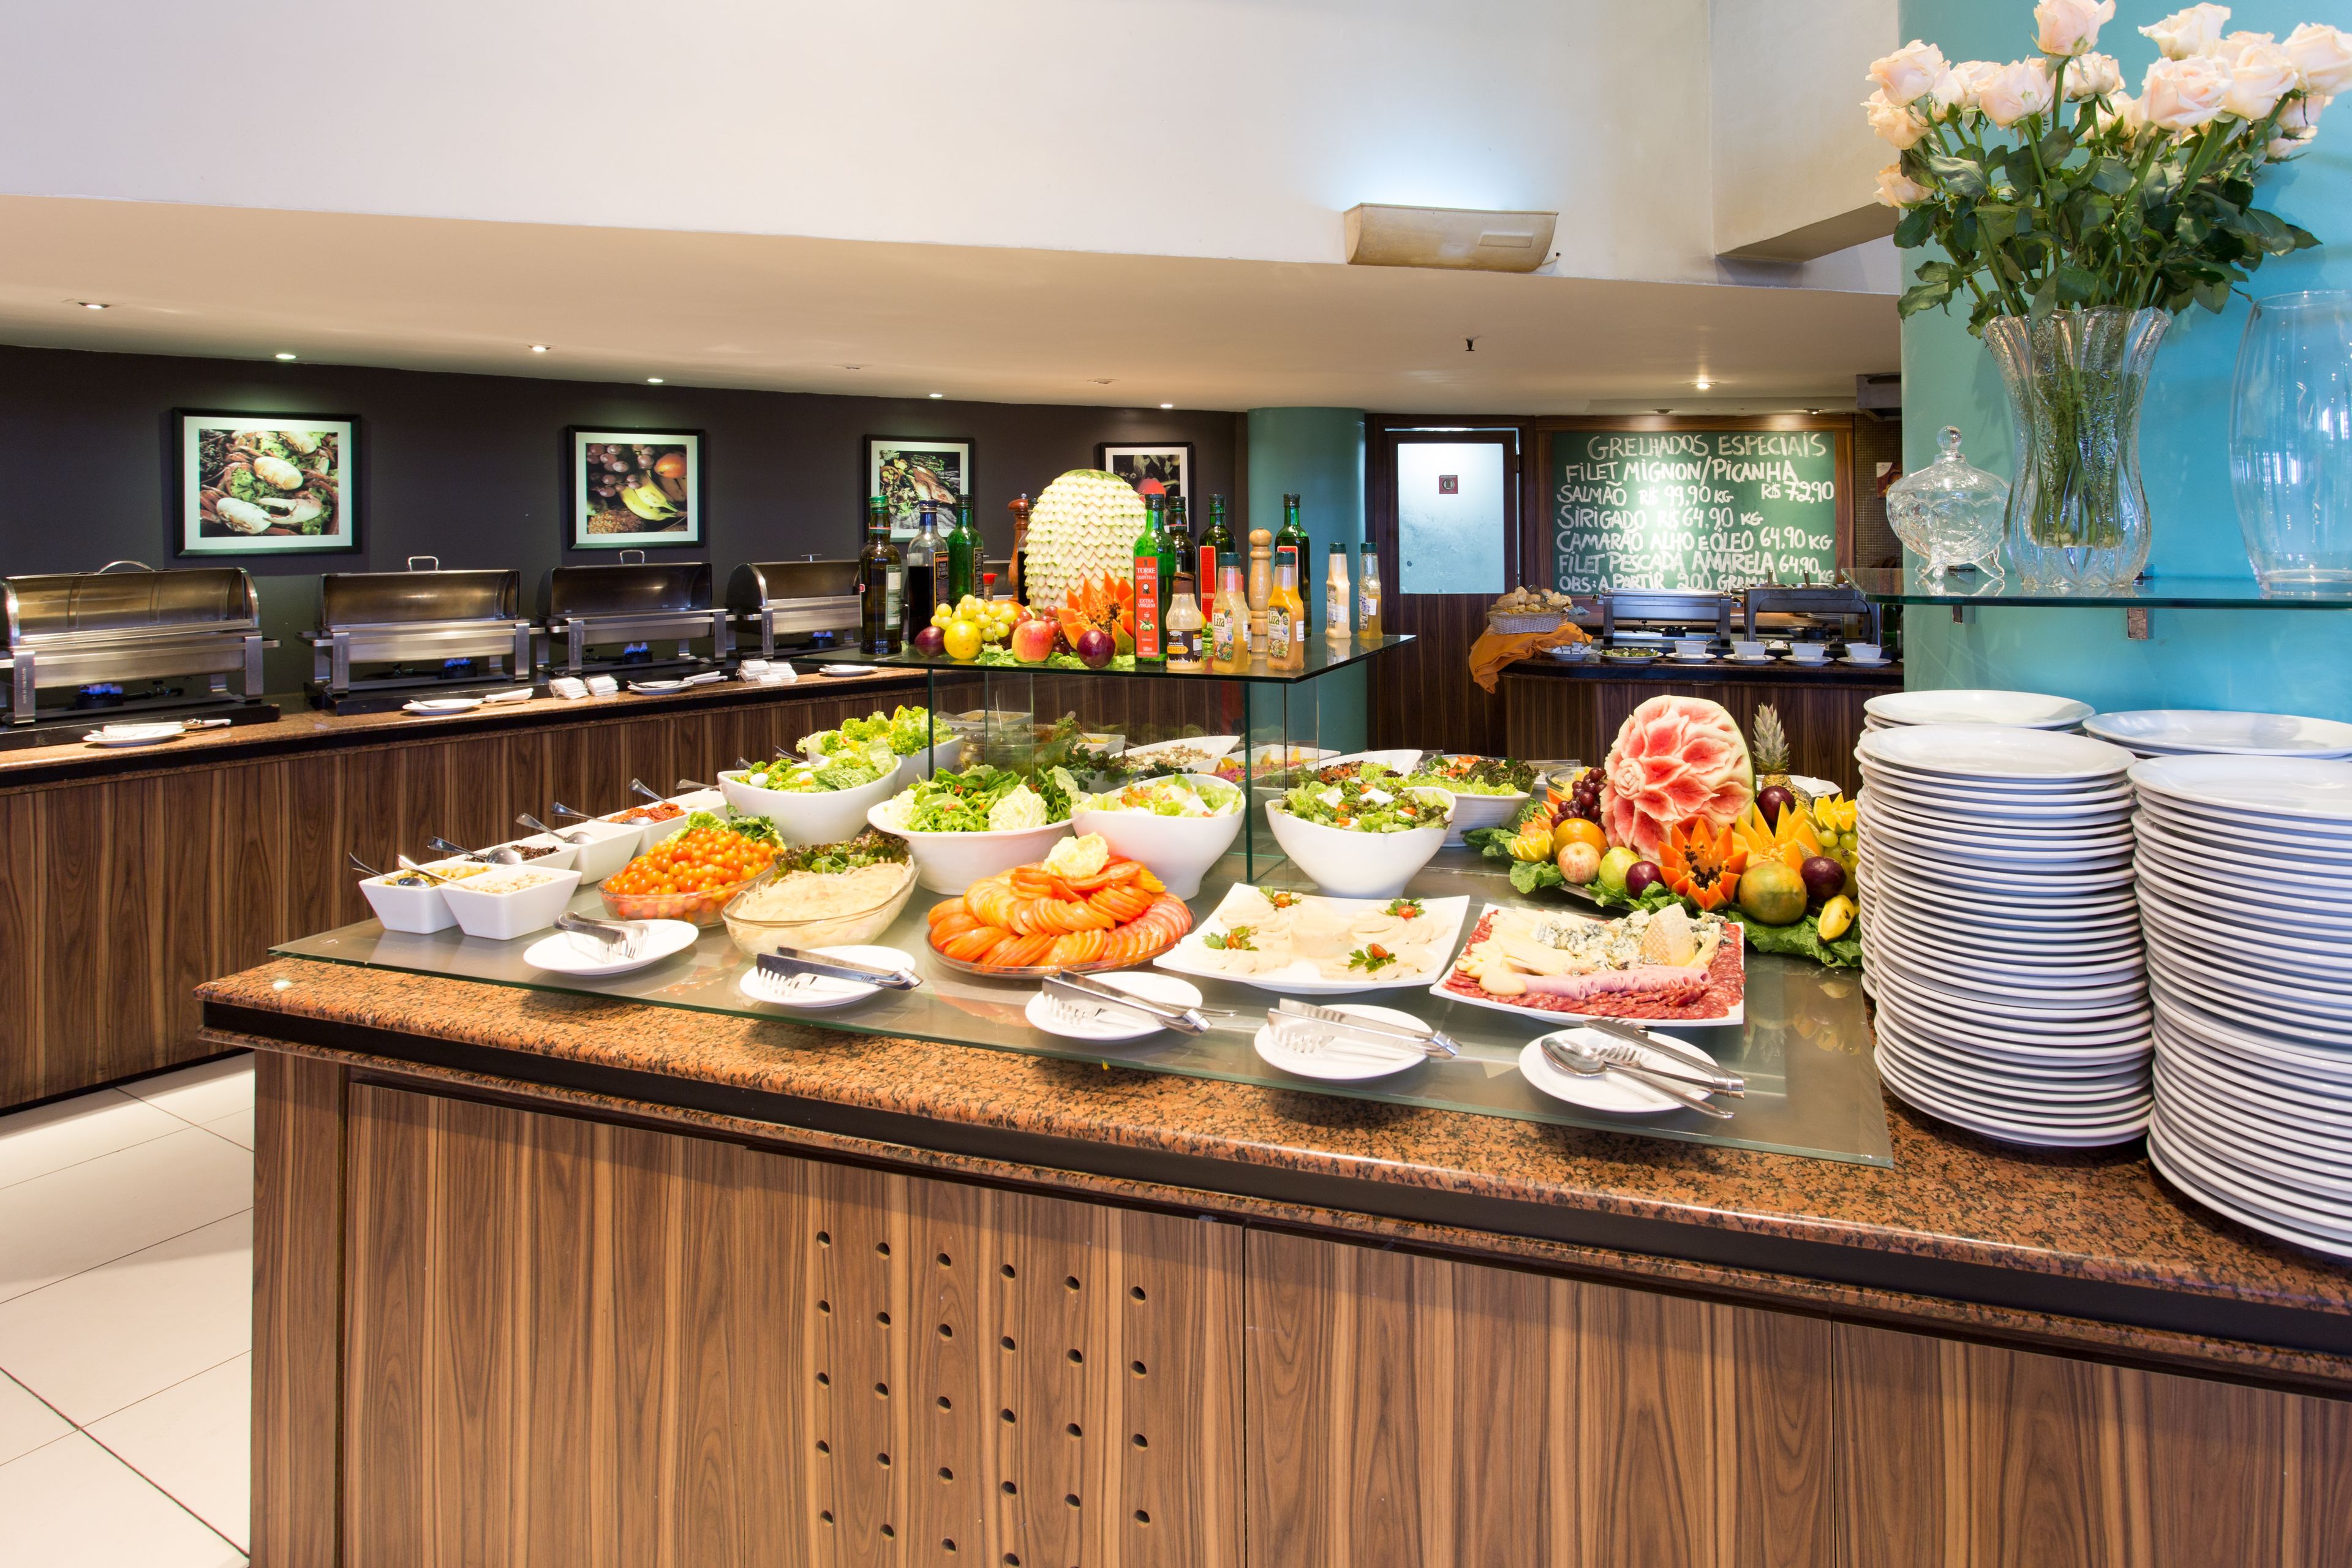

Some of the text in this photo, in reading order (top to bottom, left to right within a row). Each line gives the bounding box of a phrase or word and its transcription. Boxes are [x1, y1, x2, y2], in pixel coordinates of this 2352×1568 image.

[1588, 432, 1826, 459] GRELHADOS ESPECIAIS
[1566, 461, 1618, 483] FILET
[1556, 480, 1627, 507] SALMÃO
[1664, 485, 1711, 507] 99,90
[1714, 489, 1735, 504] KG
[1761, 480, 1834, 503] R$ 72,90
[1557, 504, 1647, 530] SIRIGADO
[1683, 507, 1734, 530] 64,90
[1740, 511, 1764, 526] KG
[1556, 528, 1644, 554] CAMARÃO
[1649, 530, 1695, 551] ALHO
[1698, 535, 1709, 551] E
[1709, 527, 1754, 552] ÓLEO
[1808, 534, 1833, 551] KG
[1559, 550, 1835, 584] FILET PESCADA AMARELA 64,90 KG
[1612, 571, 1667, 589] PARTIR
[1676, 572, 1713, 590] 200
[1213, 614, 1225, 627] Liza
[1269, 612, 1280, 625] Liza
